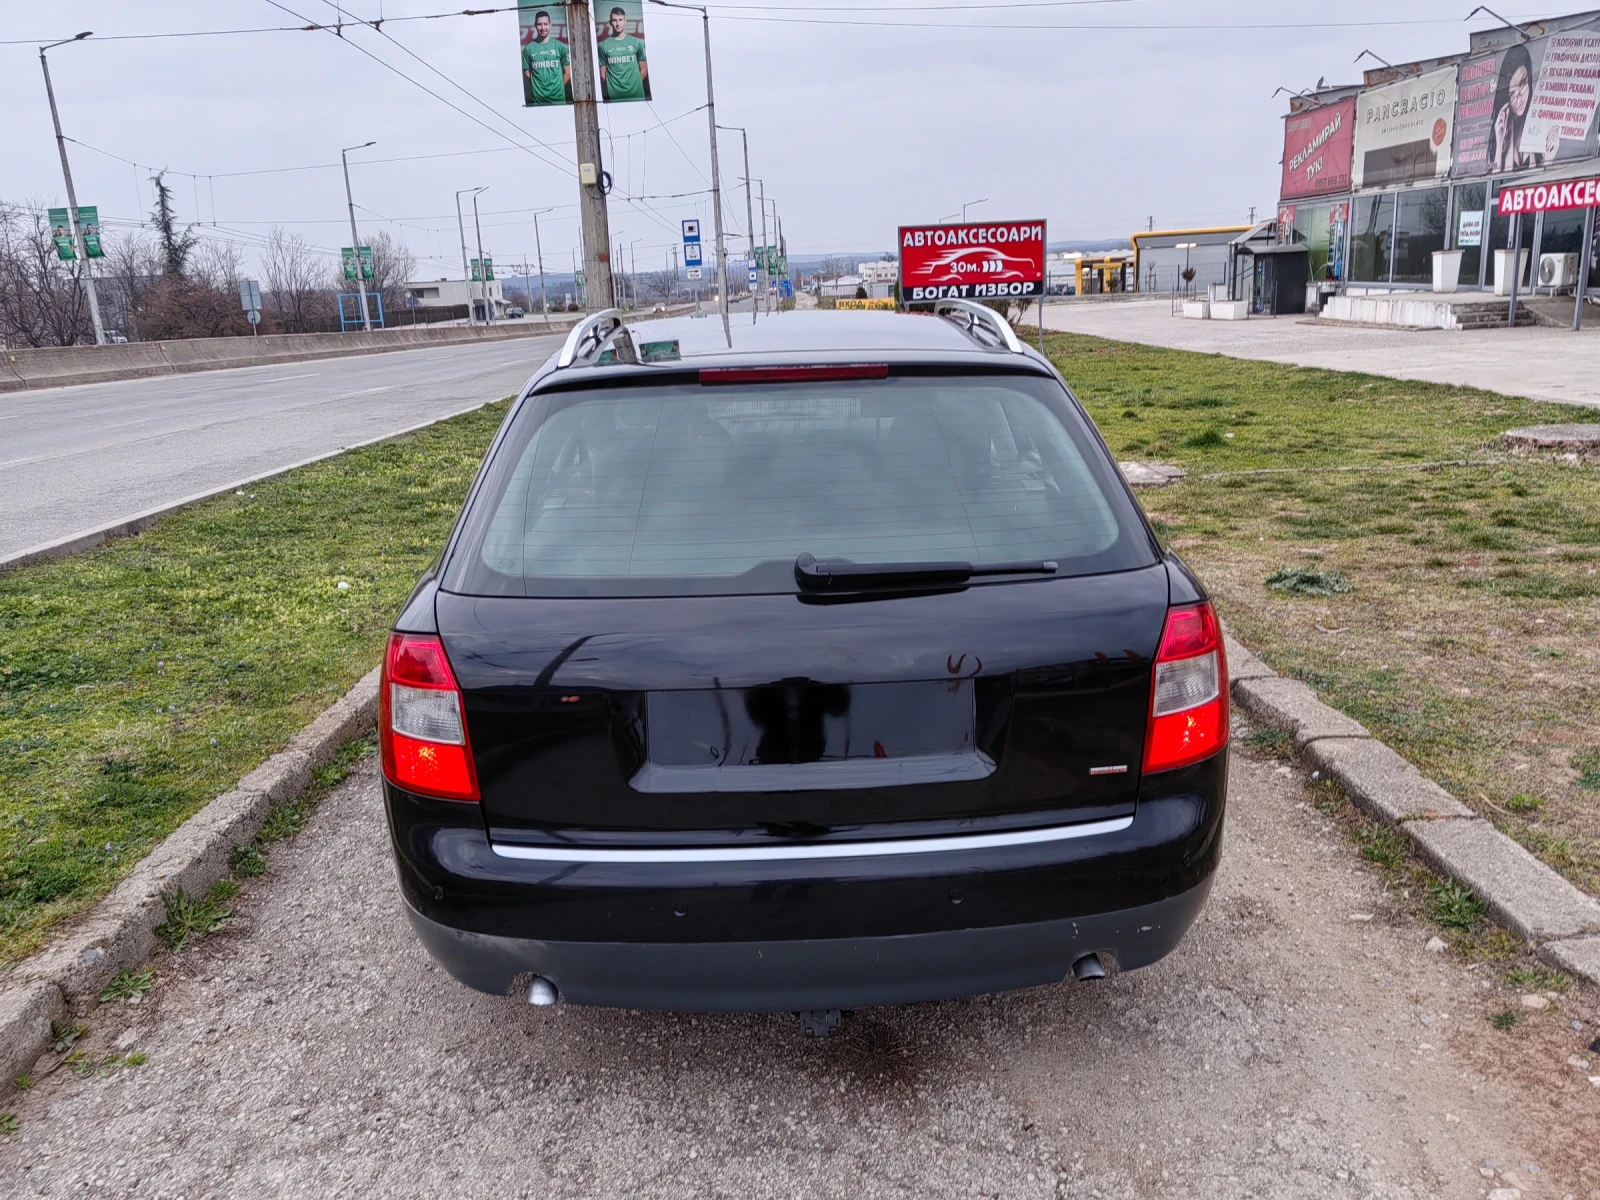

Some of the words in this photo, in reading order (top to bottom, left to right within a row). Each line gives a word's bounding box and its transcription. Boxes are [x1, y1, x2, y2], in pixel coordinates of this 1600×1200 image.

[531, 60, 560, 69] WINBET
[607, 54, 635, 64] WINBET
[1568, 83, 1595, 95] РЕКЛАМА
[1366, 88, 1446, 125] PANCRACIO
[1288, 111, 1341, 174] РЕКЛАМИРАЙ
[1306, 155, 1323, 181] ТУК!
[903, 225, 1042, 248] АВТОАКСЕСОАРИ
[912, 285, 969, 300] БОГАТ
[975, 282, 1035, 297] ИЗБОР
